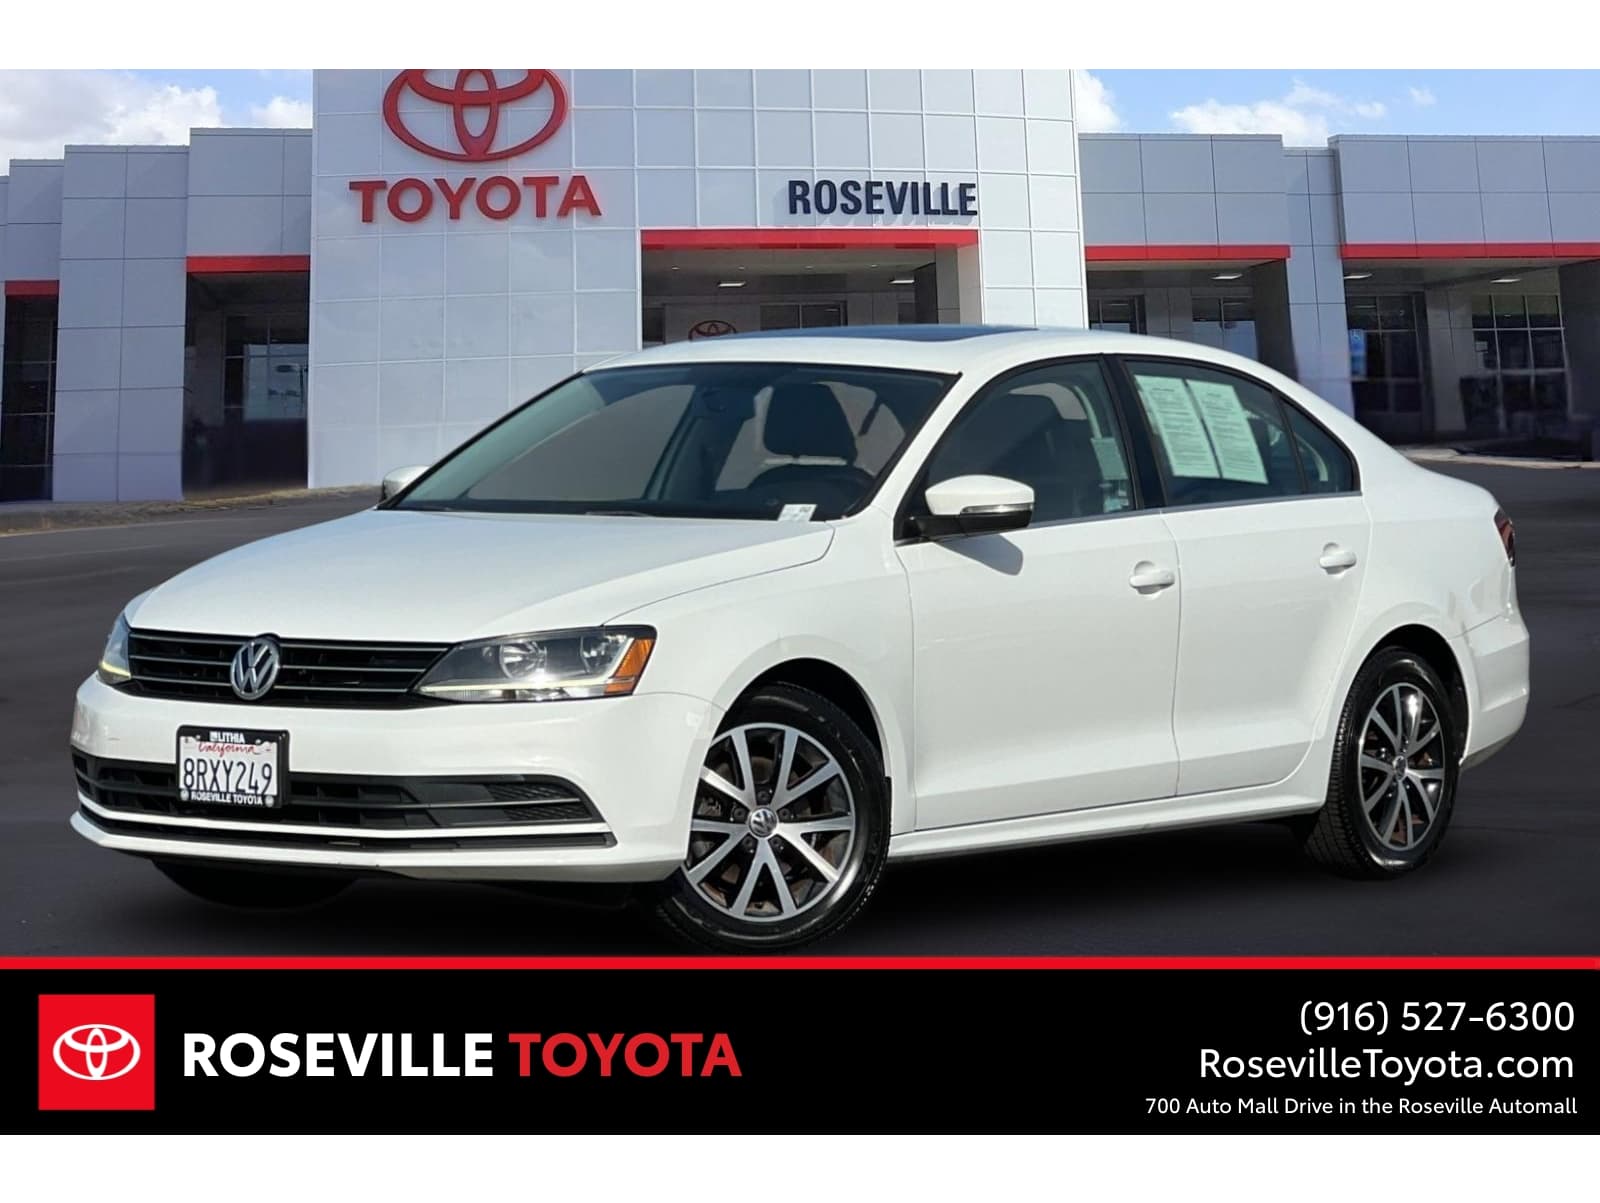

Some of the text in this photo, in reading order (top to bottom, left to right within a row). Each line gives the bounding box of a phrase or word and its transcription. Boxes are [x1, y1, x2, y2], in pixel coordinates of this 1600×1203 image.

[349, 175, 602, 223] TOYOTA
[788, 179, 979, 217] ROSEVILLE
[183, 758, 272, 796] 8RXY249
[191, 791, 263, 805] ROSEVILLE TOYOTA
